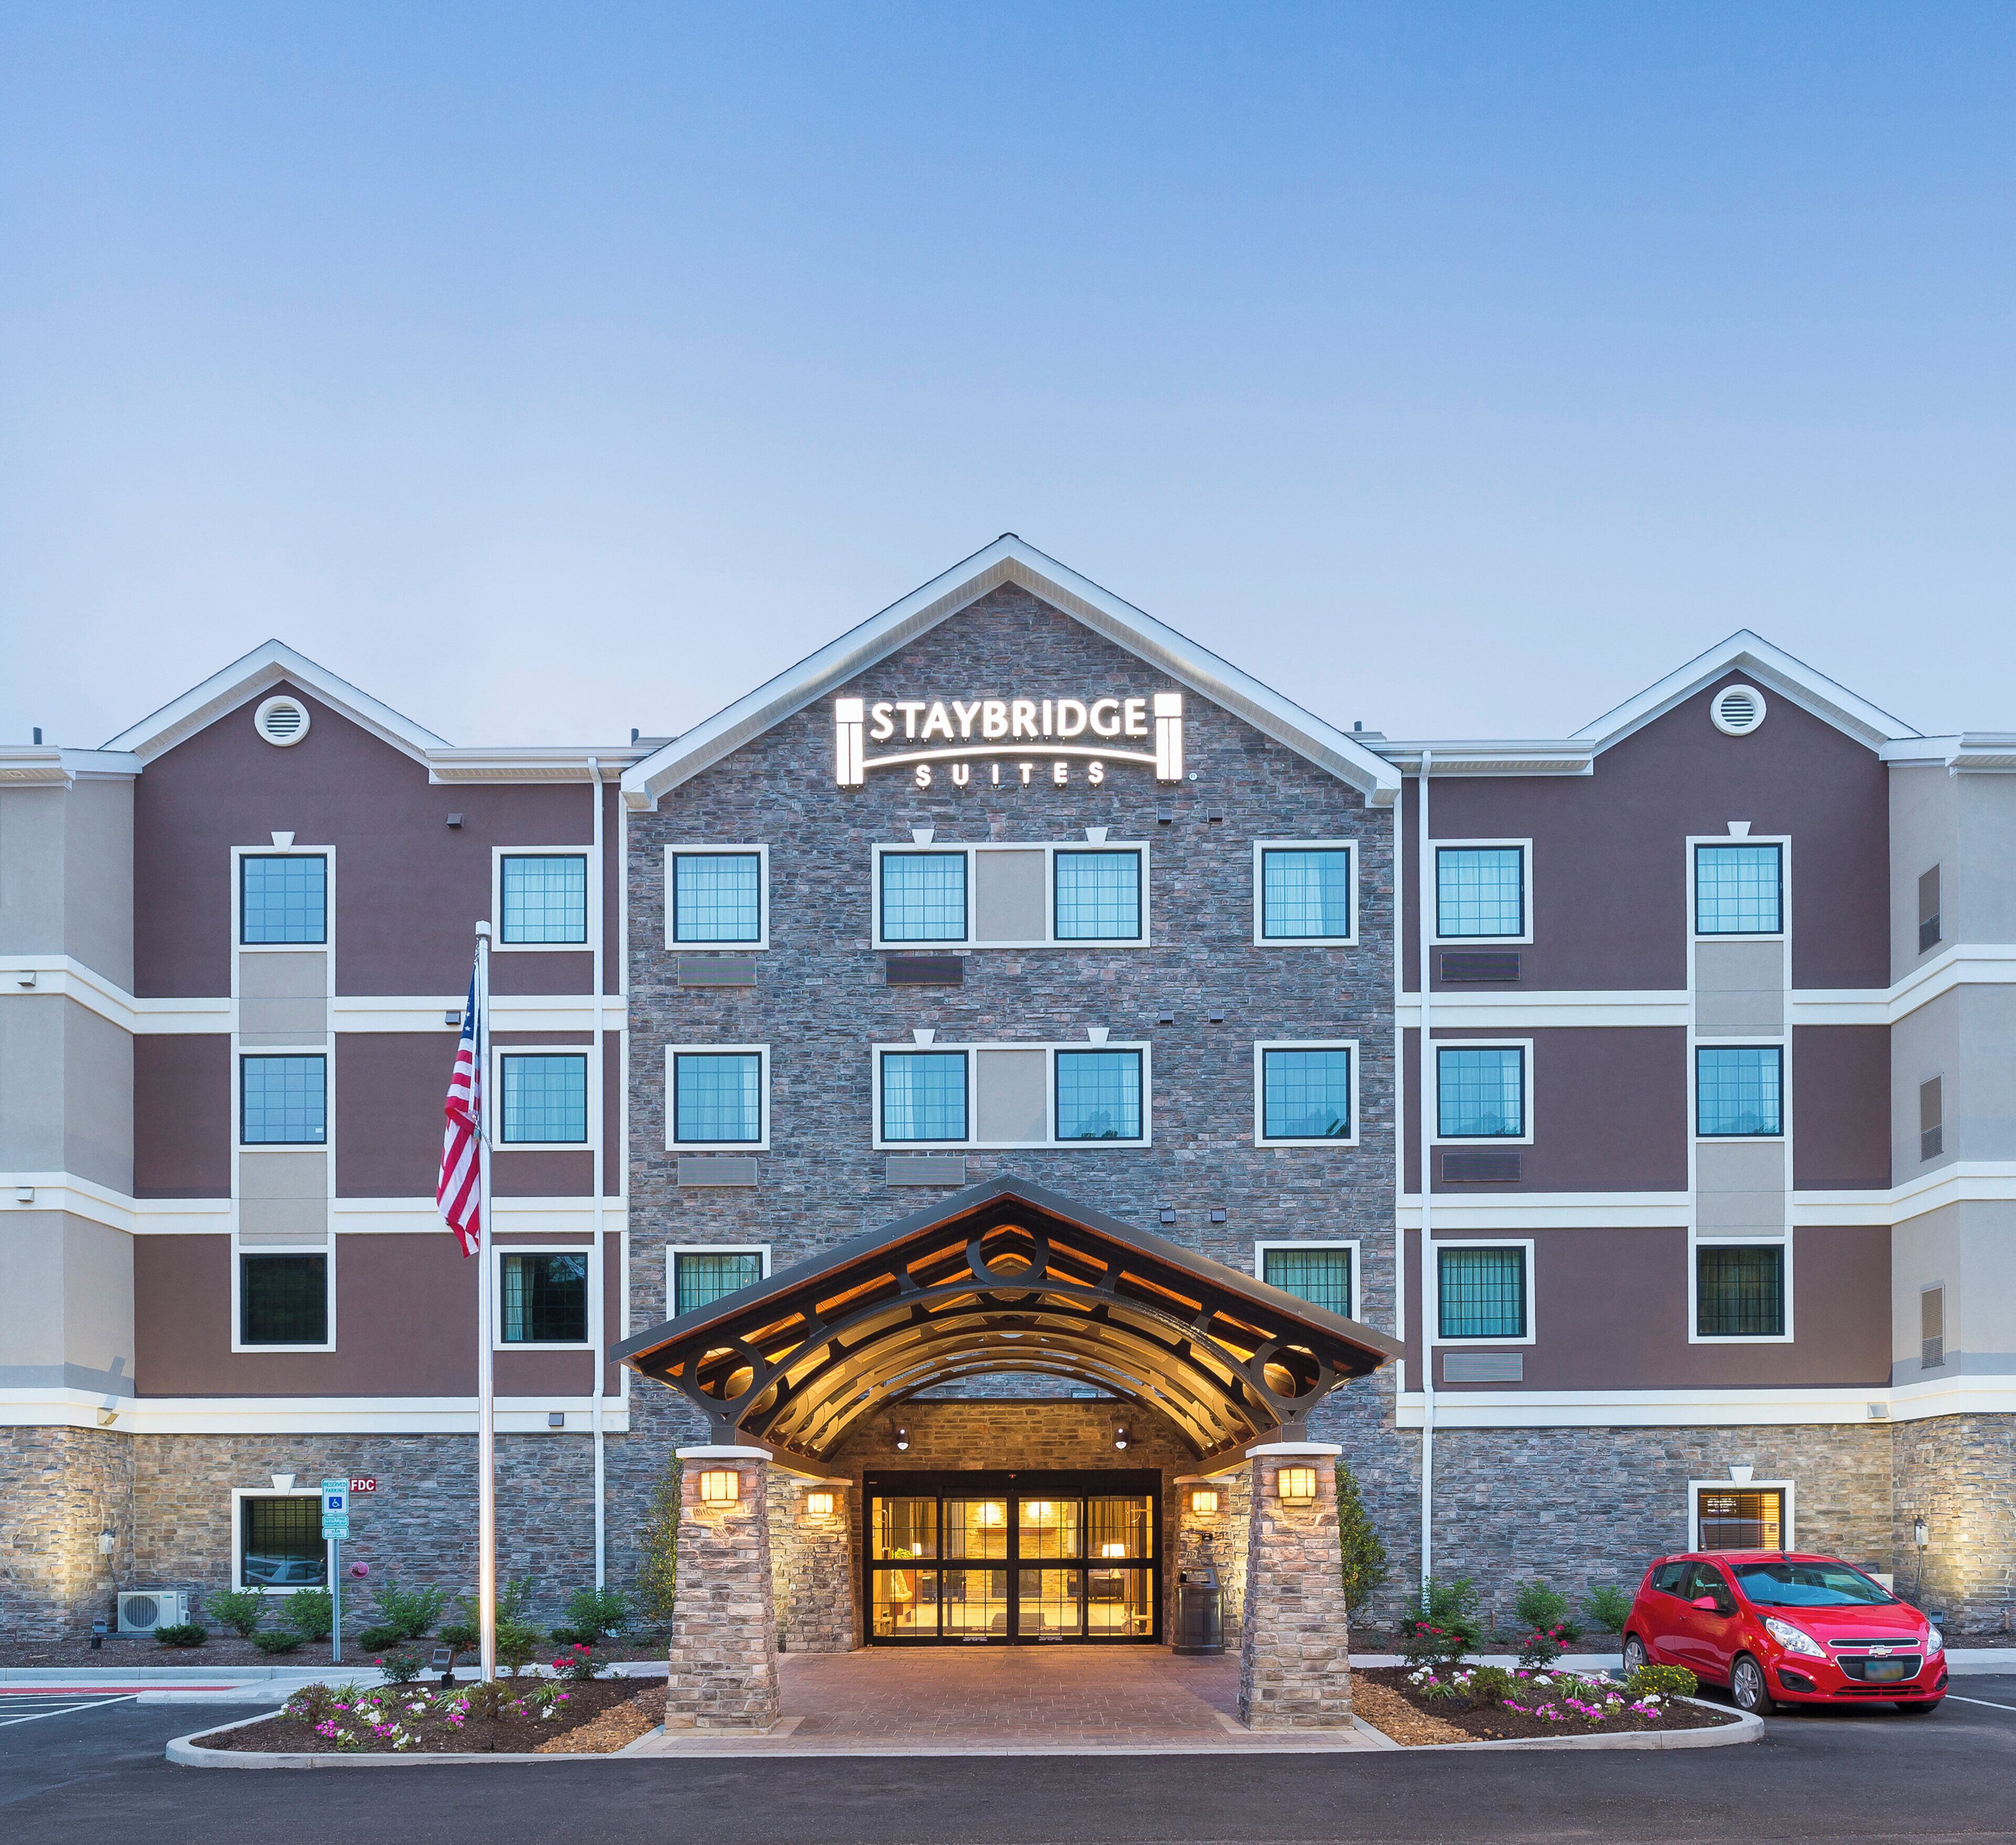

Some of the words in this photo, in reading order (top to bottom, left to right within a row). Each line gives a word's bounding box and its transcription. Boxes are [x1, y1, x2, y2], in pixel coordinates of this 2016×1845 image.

[870, 699, 1148, 739] STAYBRIDGE
[916, 761, 1104, 787] SUITES
[351, 1480, 374, 1491] FDC
